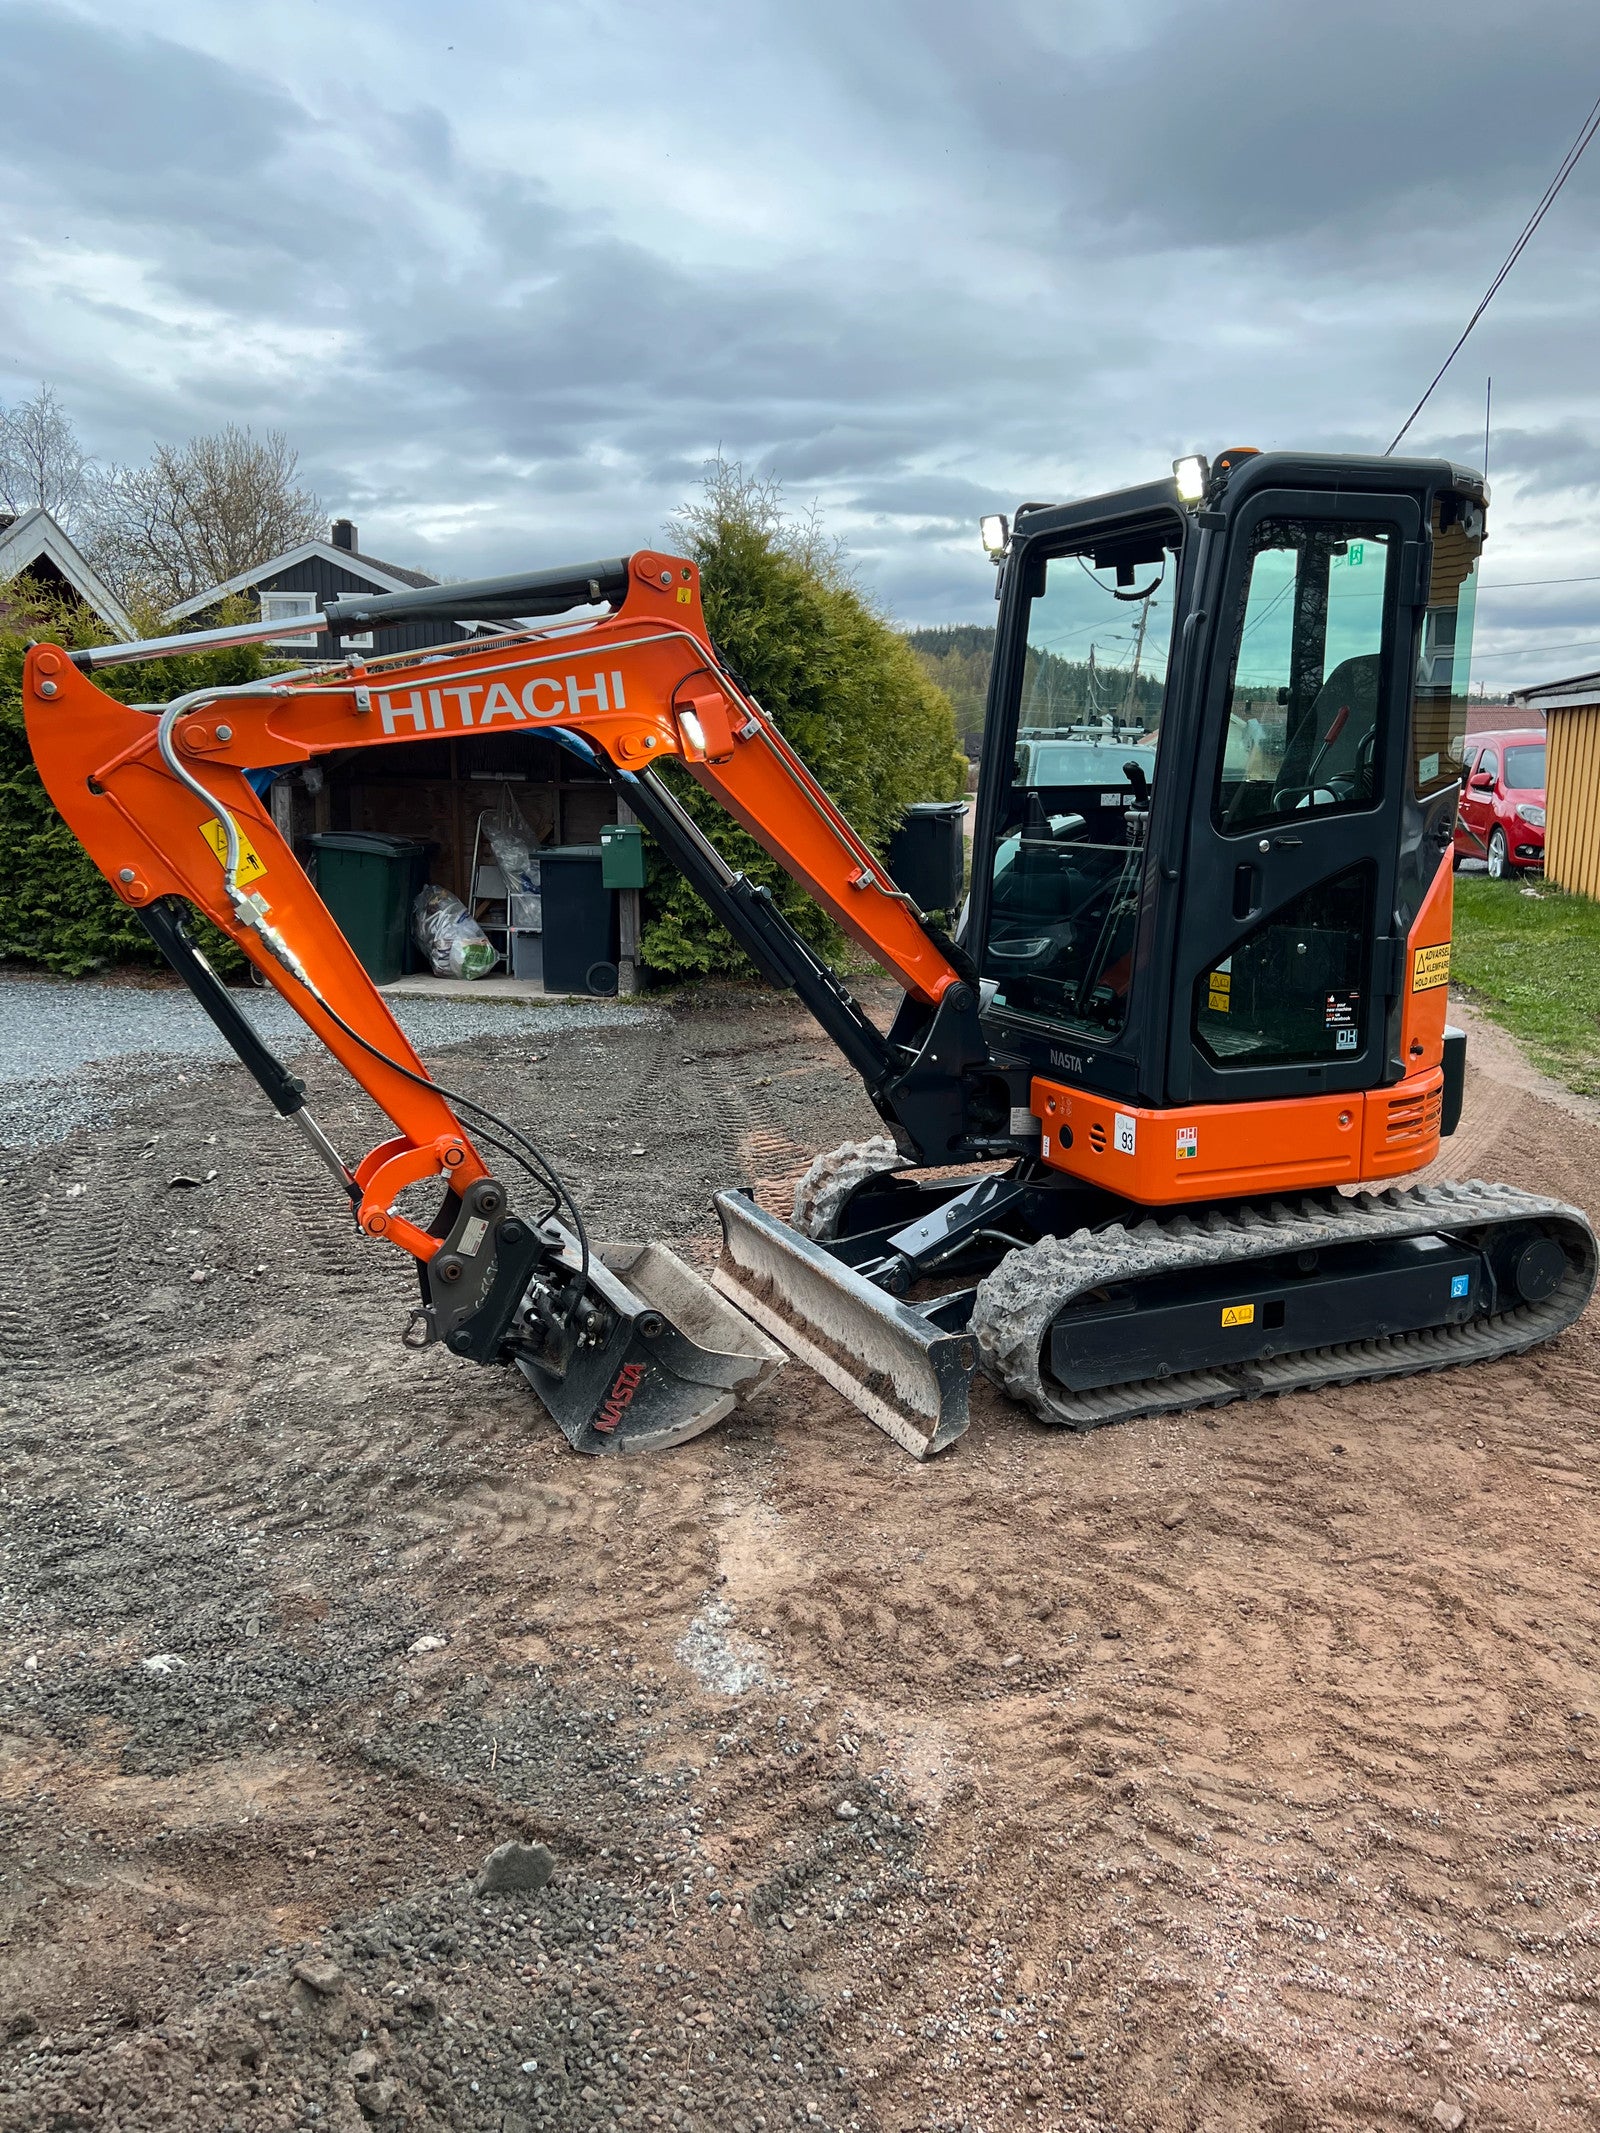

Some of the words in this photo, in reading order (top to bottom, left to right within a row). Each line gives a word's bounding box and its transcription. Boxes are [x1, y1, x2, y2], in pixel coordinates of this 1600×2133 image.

[378, 671, 626, 734] HITACHI
[1425, 947, 1449, 960] ADVARSEL
[1426, 960, 1449, 972] KLEMFARE
[1415, 977, 1428, 988] HOLD
[1429, 972, 1448, 984] AVSTAND
[1050, 1049, 1083, 1074] NASTA
[1121, 1131, 1133, 1151] 93
[592, 1361, 647, 1435] NASTA
